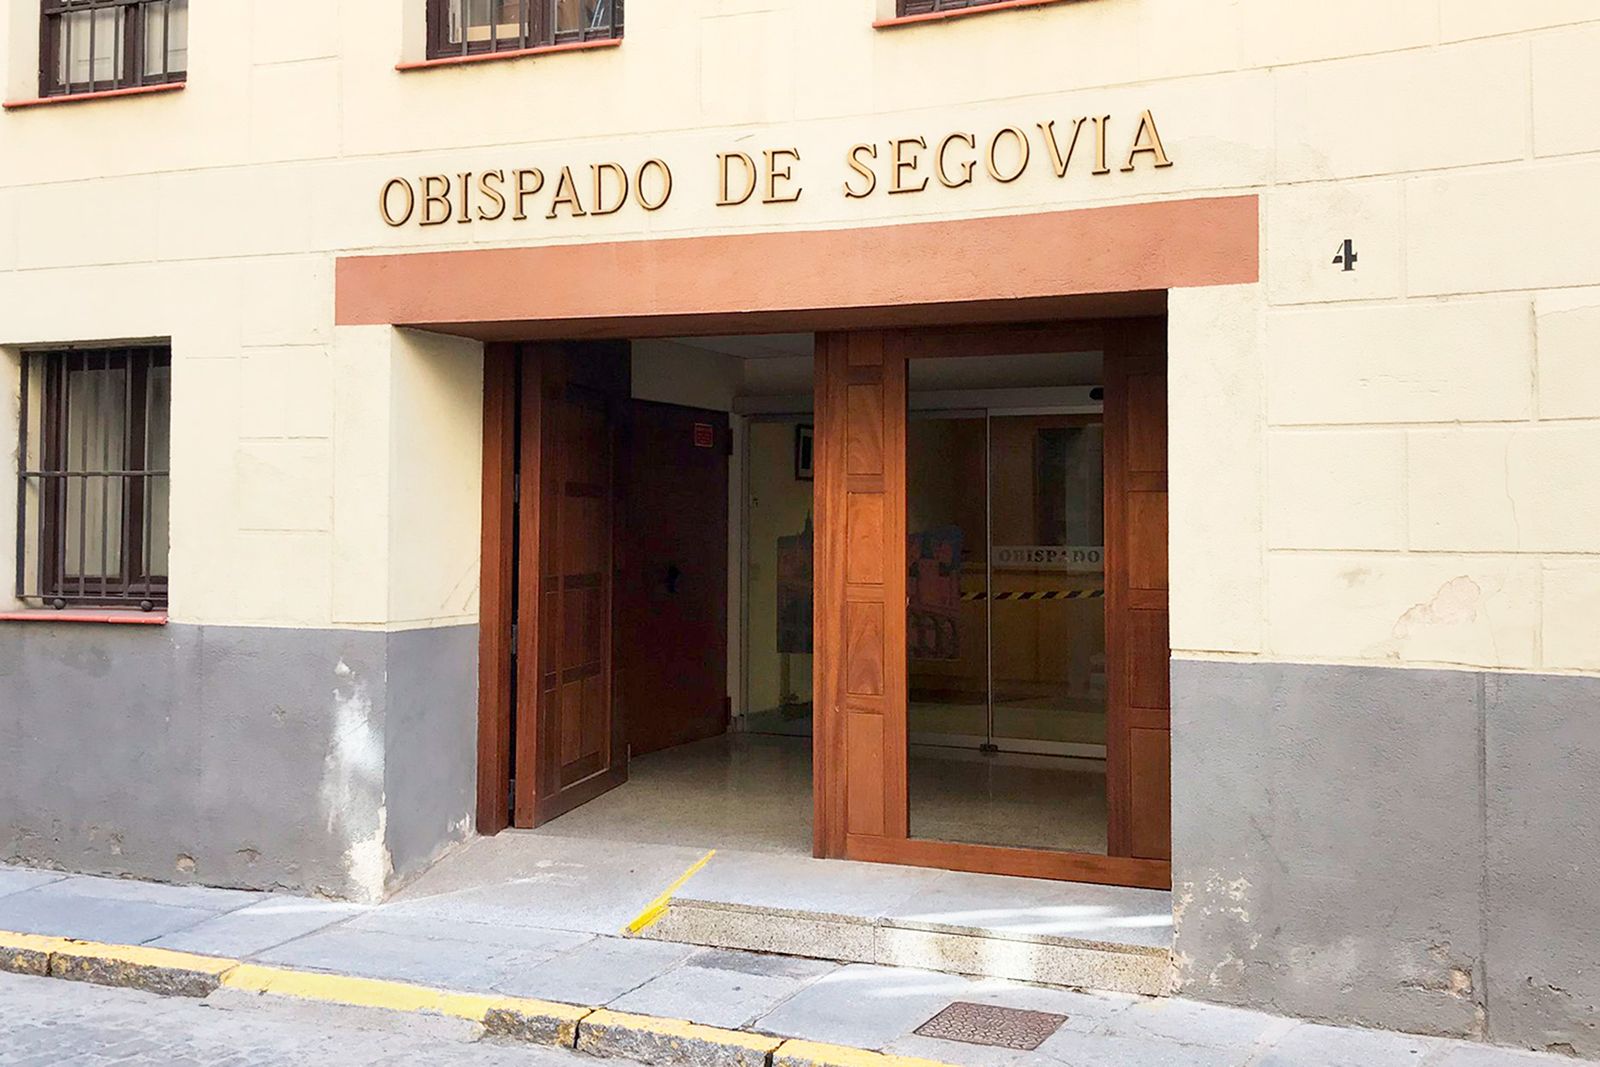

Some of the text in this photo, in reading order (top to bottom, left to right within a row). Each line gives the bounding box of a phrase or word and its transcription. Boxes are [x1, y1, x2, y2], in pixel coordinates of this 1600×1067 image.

[379, 109, 1174, 227] OBISPADO DE SEGOVIA
[1332, 239, 1358, 272] 4
